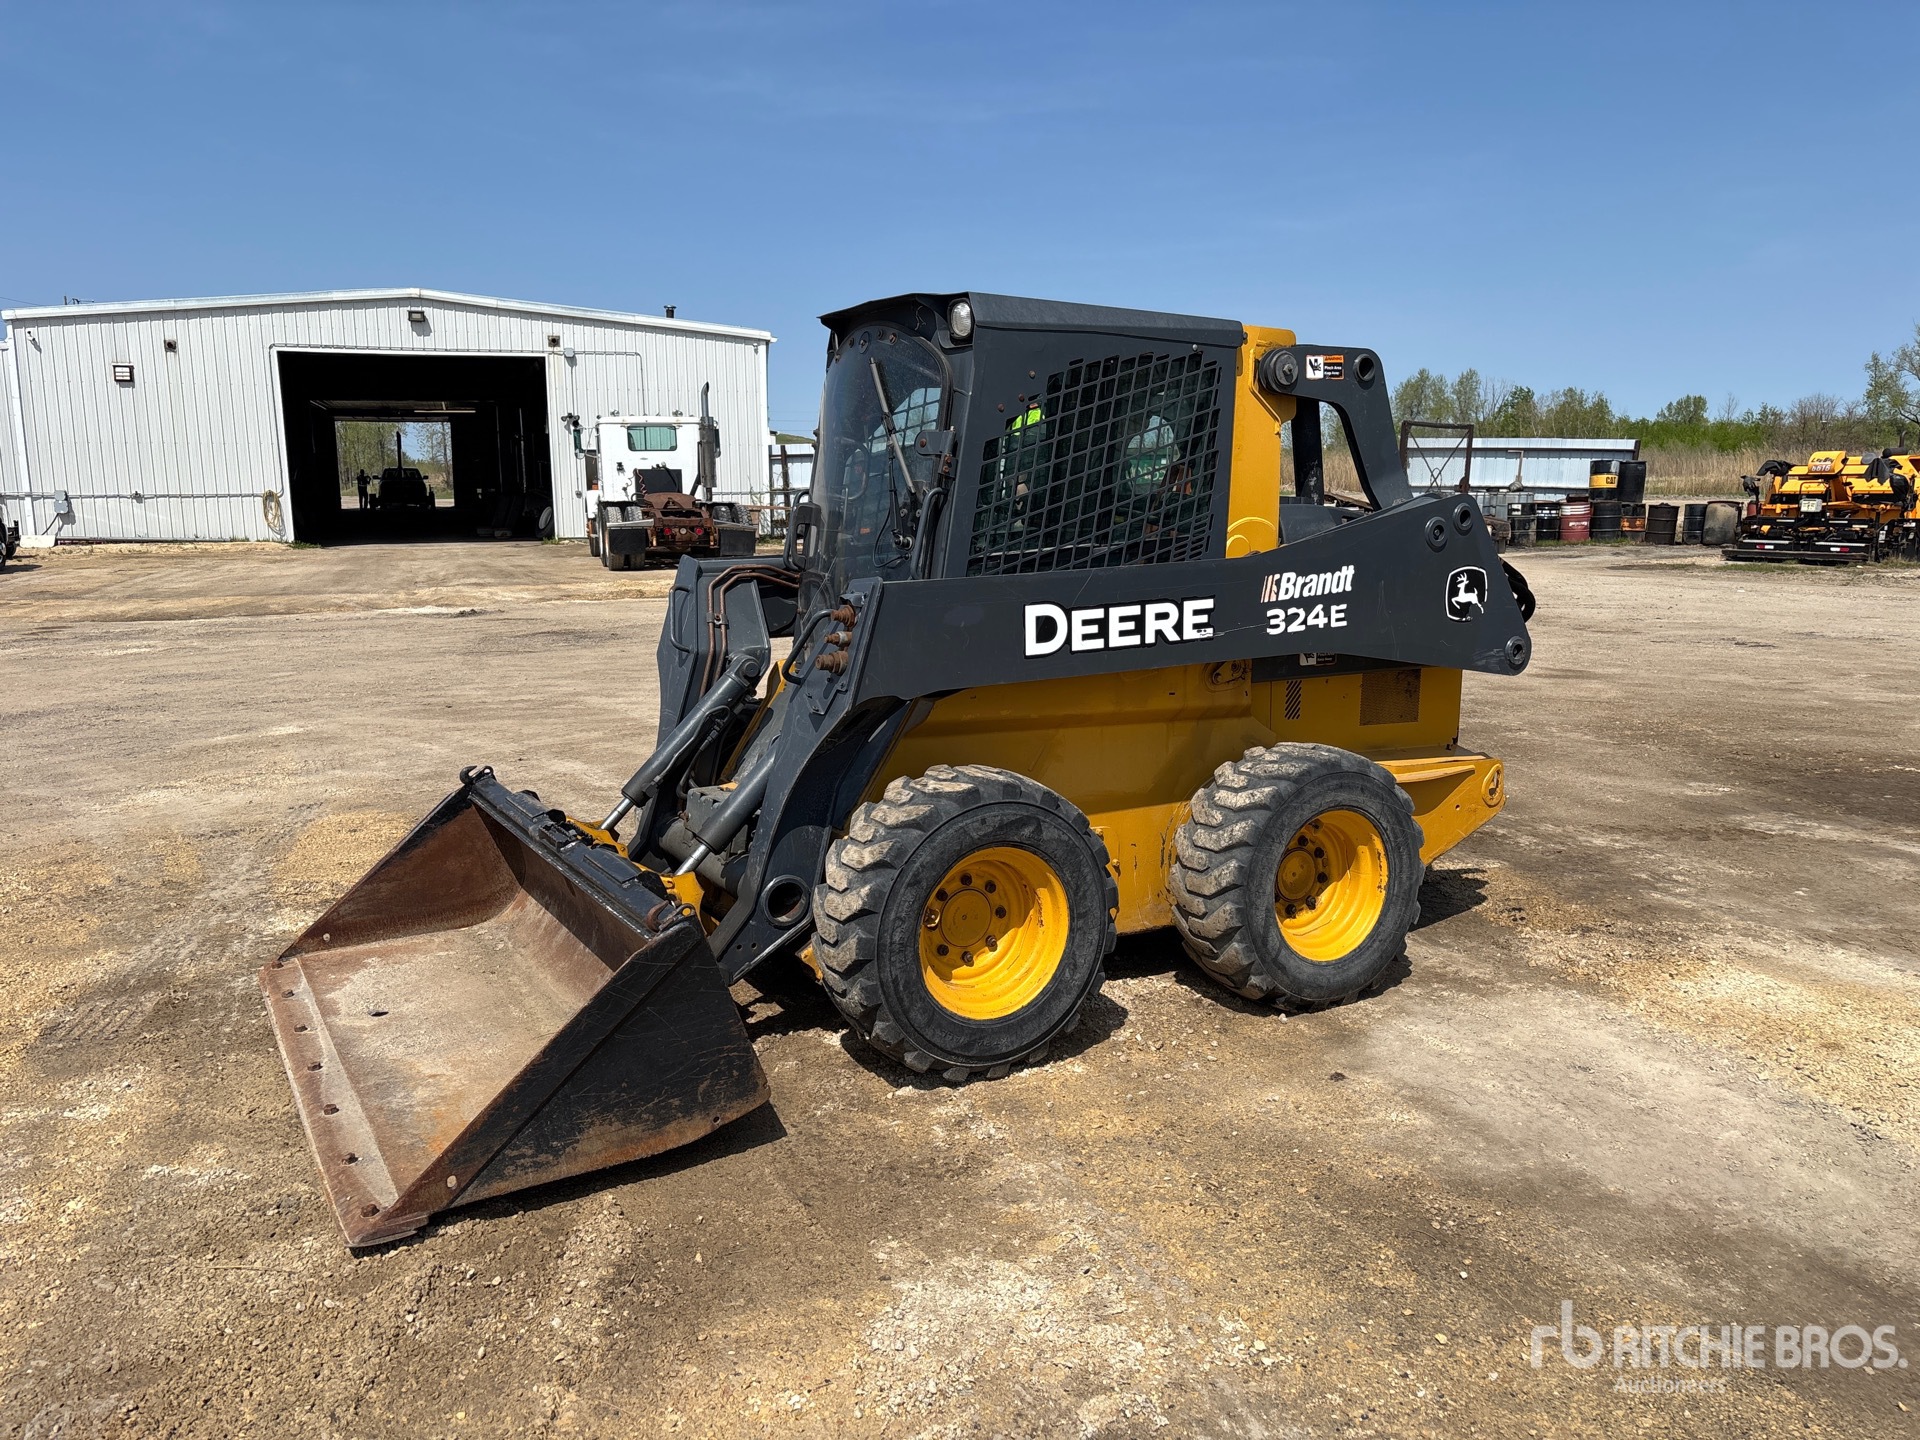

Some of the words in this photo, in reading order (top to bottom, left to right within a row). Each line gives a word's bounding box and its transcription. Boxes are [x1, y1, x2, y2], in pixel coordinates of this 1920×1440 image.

[1605, 476, 1617, 485] CAT
[1278, 565, 1355, 601] Brandt
[1024, 598, 1215, 656] DEERE
[1266, 603, 1348, 635] 324E
